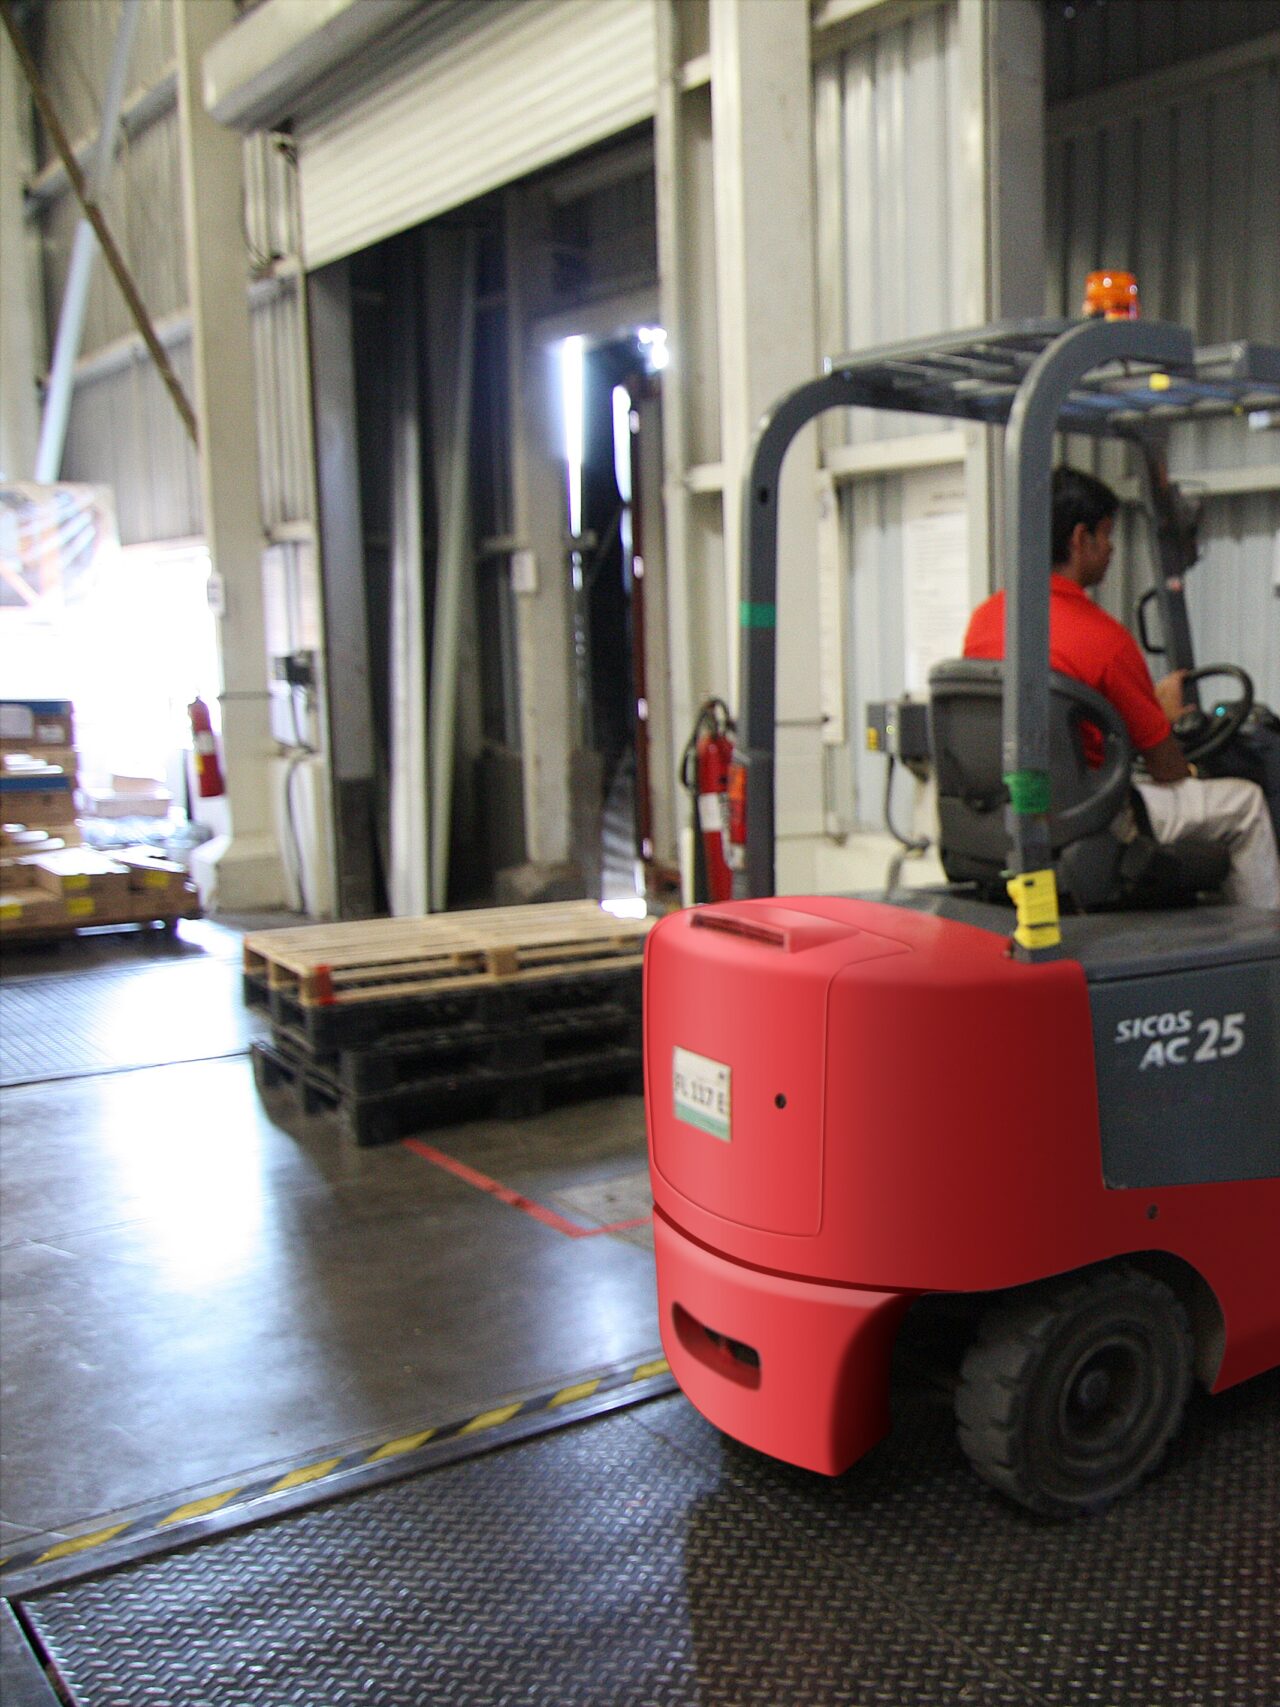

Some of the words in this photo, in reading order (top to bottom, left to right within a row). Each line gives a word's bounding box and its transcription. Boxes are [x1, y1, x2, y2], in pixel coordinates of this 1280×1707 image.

[1114, 1010, 1193, 1043] SICOS
[1138, 1037, 1190, 1071] AC
[1194, 1012, 1245, 1062] 25
